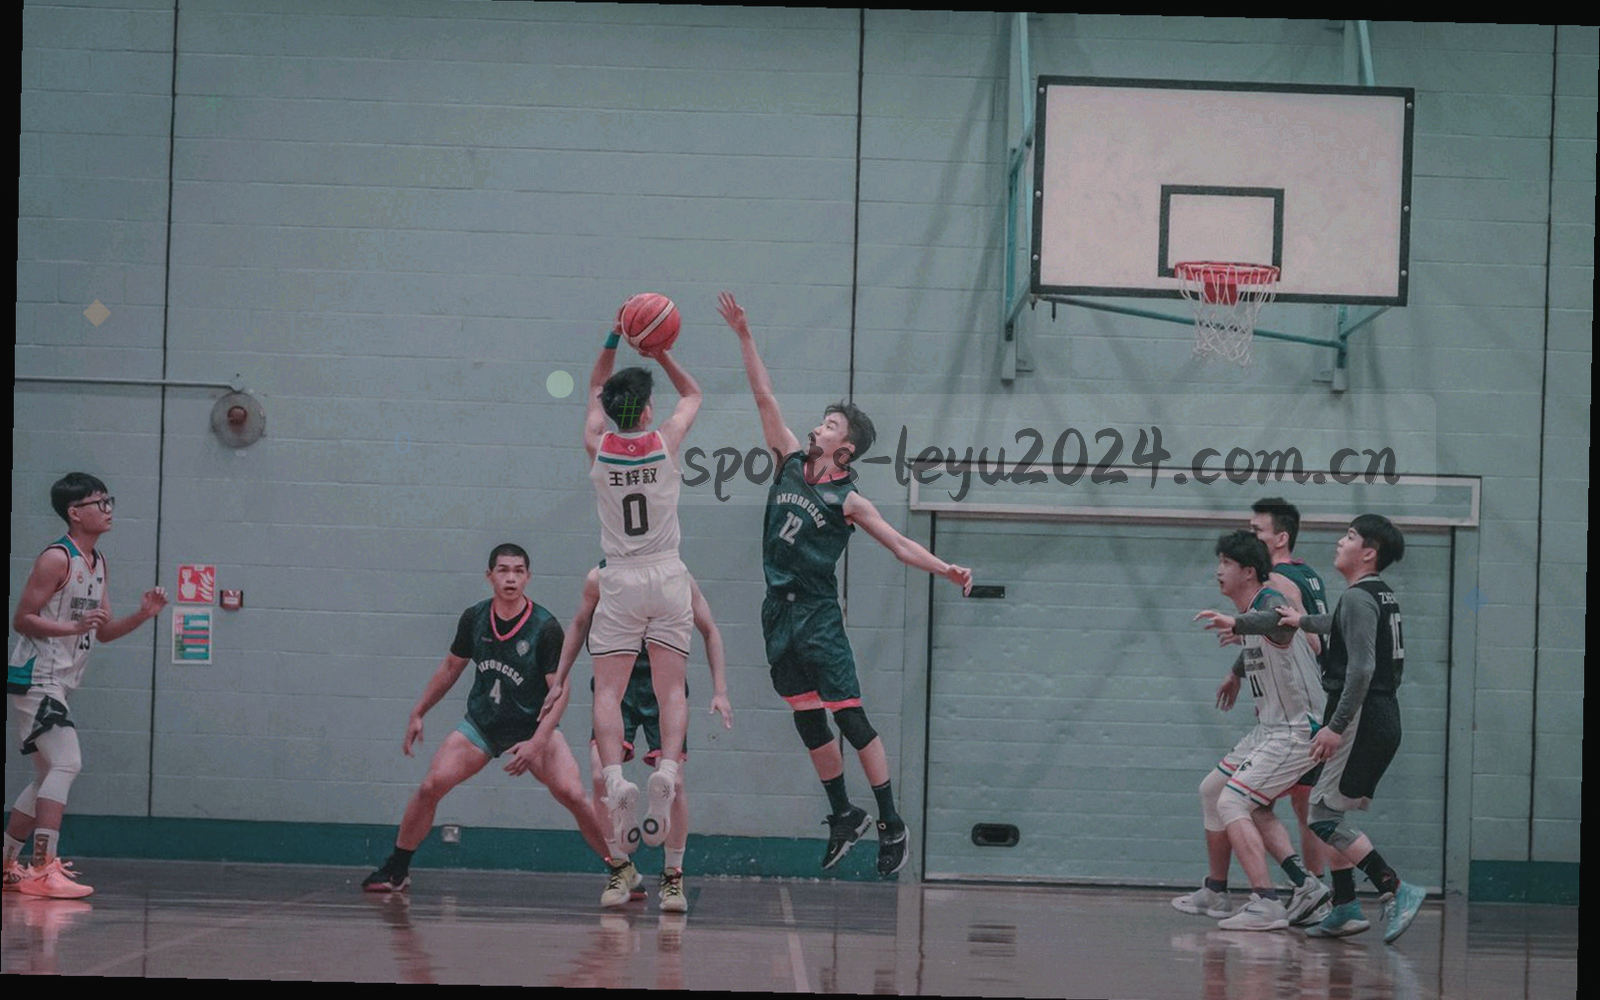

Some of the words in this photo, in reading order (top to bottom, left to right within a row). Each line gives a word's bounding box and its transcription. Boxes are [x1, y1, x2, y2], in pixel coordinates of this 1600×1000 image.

[622, 493, 649, 536] 0
[779, 511, 803, 544] 12
[489, 677, 502, 705] 4
[1249, 673, 1264, 698] 11
